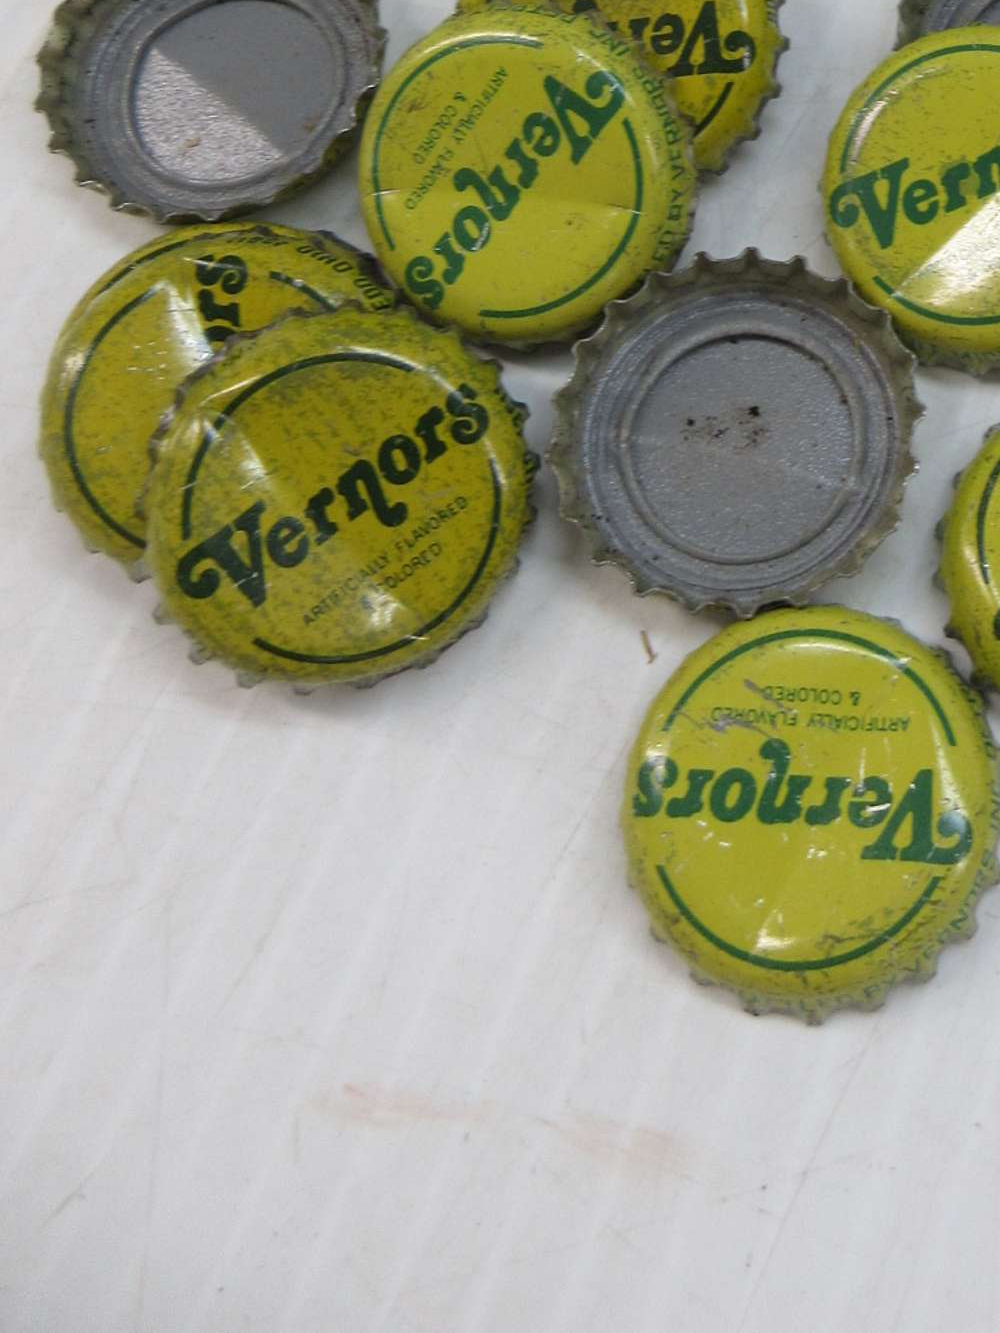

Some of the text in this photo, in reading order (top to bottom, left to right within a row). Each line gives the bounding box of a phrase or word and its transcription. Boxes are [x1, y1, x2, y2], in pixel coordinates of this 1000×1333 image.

[404, 68, 509, 211] ARTIFICIALLY FLAVORED
[404, 69, 625, 311] Vernors
[414, 91, 467, 165] & COLORED
[176, 383, 489, 608] Vernors
[302, 495, 469, 626] ARTIFICIALLY FLAVORED
[710, 705, 909, 733] ARTIFICIALLY FLAVORED
[762, 685, 861, 707] & COLORED
[633, 737, 974, 865] Vernors
